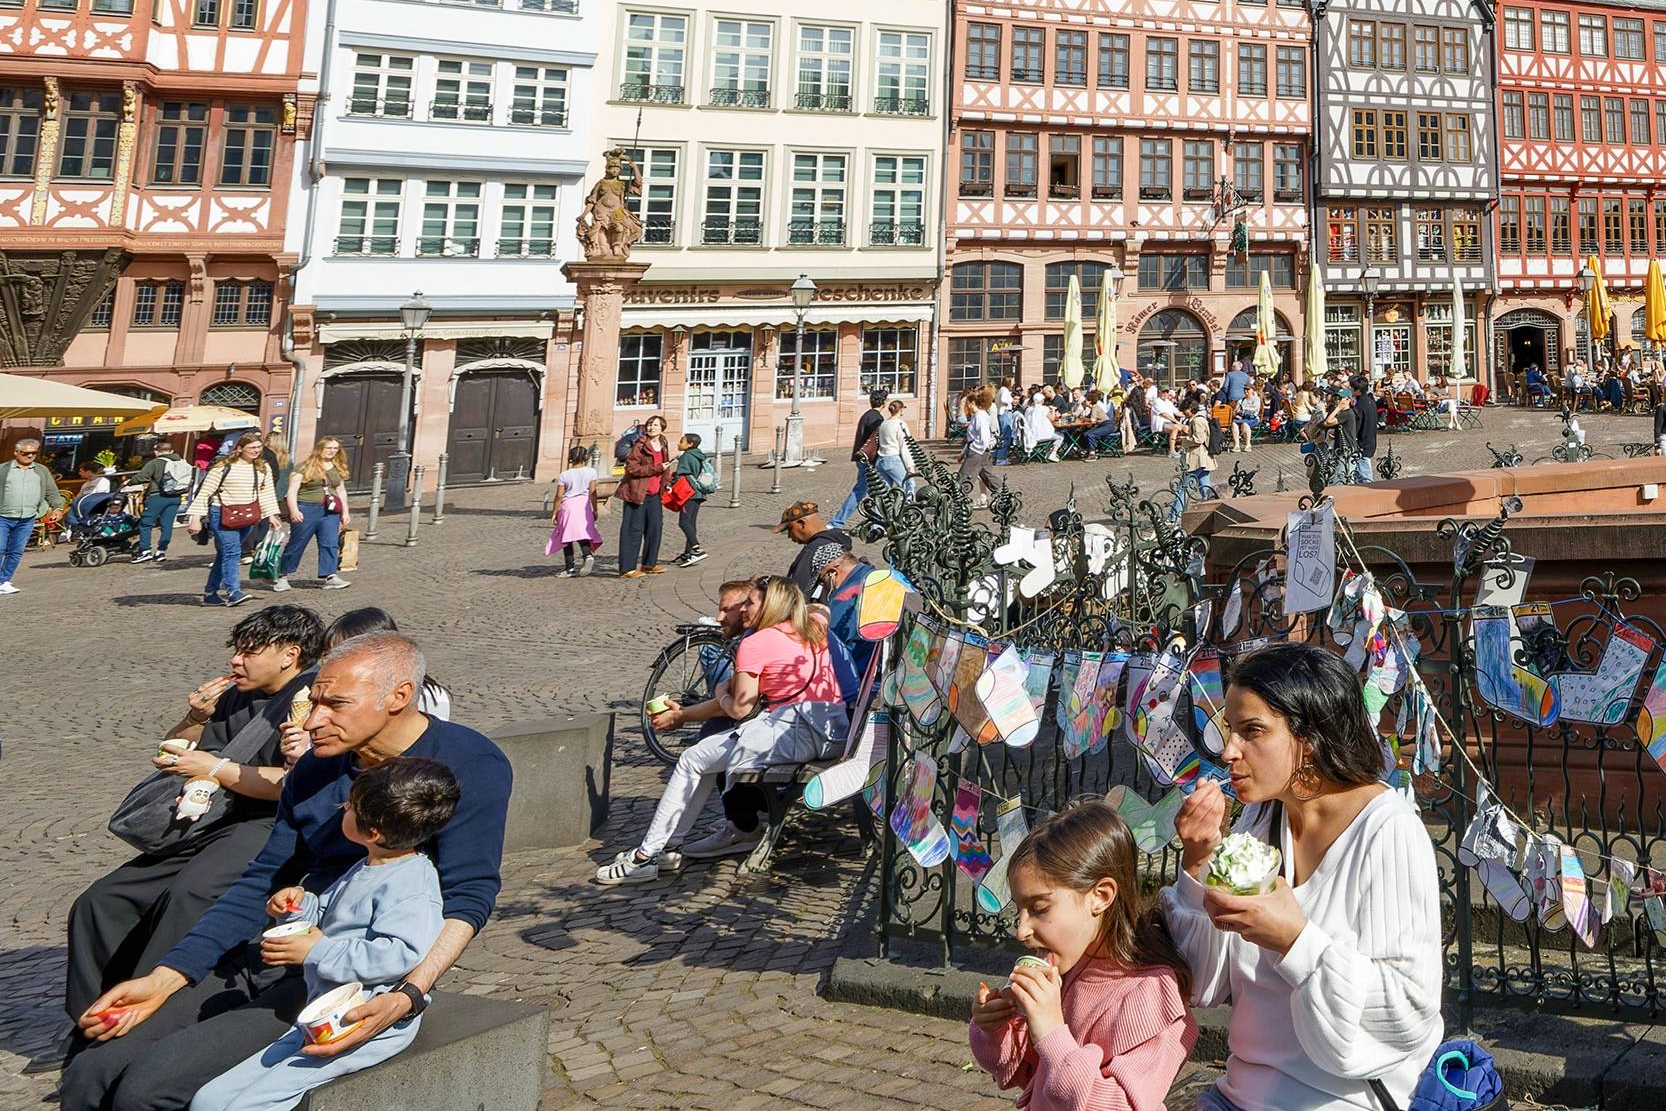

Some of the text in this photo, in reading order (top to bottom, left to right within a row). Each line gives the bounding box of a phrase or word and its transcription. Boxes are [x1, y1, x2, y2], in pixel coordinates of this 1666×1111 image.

[622, 287, 720, 304] uvenirs
[811, 284, 924, 301] eschenke
[1125, 301, 1159, 335] Römer
[1299, 550, 1317, 559] LOS?
